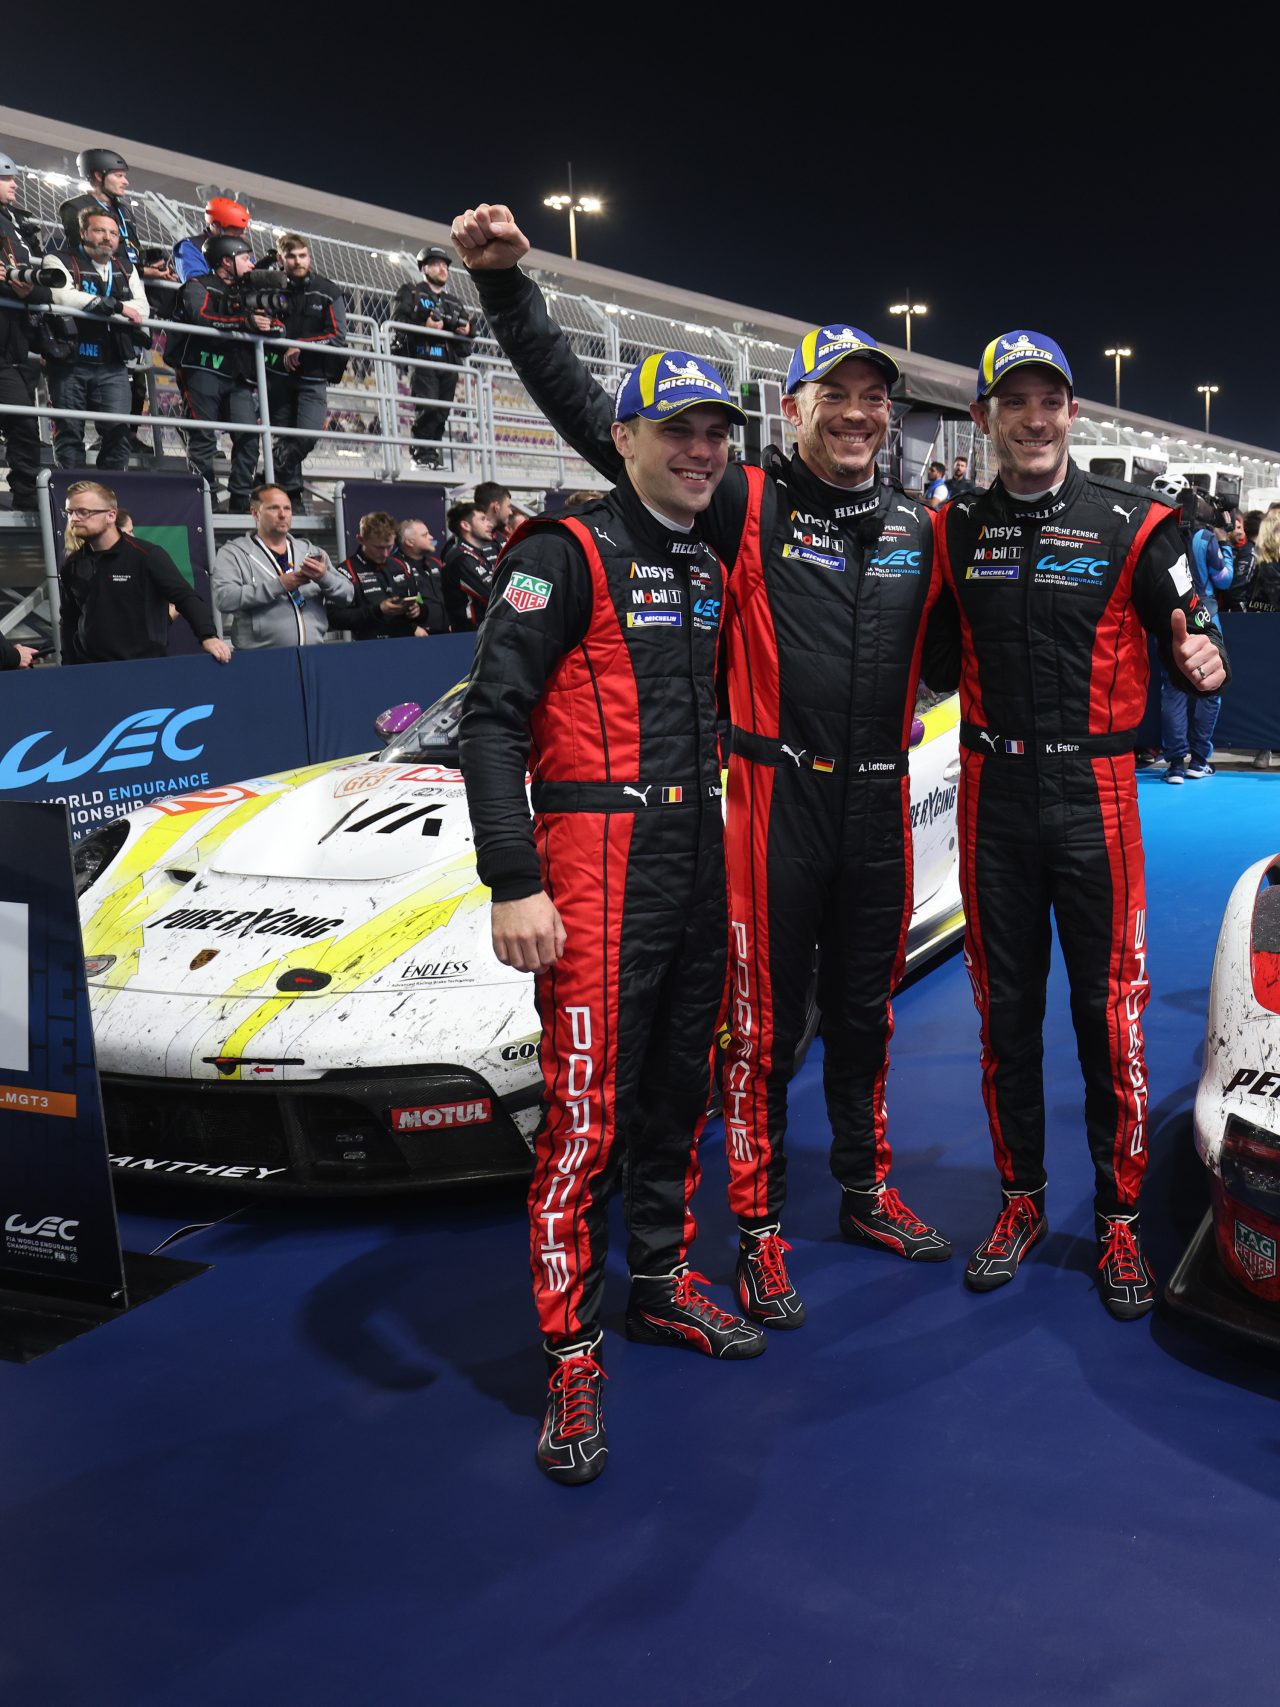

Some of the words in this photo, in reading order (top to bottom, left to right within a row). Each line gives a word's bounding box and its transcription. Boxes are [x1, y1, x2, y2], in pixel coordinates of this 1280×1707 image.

[200, 351, 224, 369] TV
[995, 349, 1053, 371] MICHELIN
[658, 381, 722, 395] MICHELIN
[834, 496, 880, 519] HELLER
[790, 510, 839, 532] Ansys
[793, 528, 830, 549] Mobil
[978, 525, 1022, 541] Ansys
[1041, 525, 1070, 536] PORSCHE
[1071, 530, 1099, 540] PENSKE
[1040, 538, 1084, 549] MOTORSPORT
[801, 552, 840, 567] MICHELIN
[974, 548, 1007, 560] Mobil
[630, 562, 675, 582] Ansys
[1036, 554, 1110, 577] WEC
[511, 574, 549, 595] TAG
[1034, 578, 1079, 587] CHAMPIONSHIP
[1067, 576, 1103, 586] ENDURANCE
[508, 588, 545, 610] HEUER
[632, 590, 667, 605] Mobil
[644, 614, 677, 622] MICHELIN
[0, 704, 215, 790] WEC
[1046, 743, 1056, 753] K.
[1057, 742, 1080, 753] Estre
[858, 764, 867, 773] A.
[868, 761, 896, 772] Lotterer
[108, 772, 210, 801] ENDURANCE
[343, 774, 388, 792] GT3
[401, 960, 471, 979] ENDLESS
[730, 920, 755, 1163] PORSCHE
[1124, 908, 1149, 1157] PORSCHE
[0, 1092, 49, 1108] MGT3
[398, 1102, 488, 1129] MOTUL
[540, 1005, 594, 1293] PORSCHE
[109, 1153, 287, 1180] ANTHEY
[5, 1214, 80, 1241] WEC
[7, 1242, 54, 1254] CHAMPIONSHIP
[17, 1237, 39, 1246] WORLD
[40, 1241, 78, 1253] ENDURANCE
[1236, 1223, 1273, 1255] TAG
[1236, 1244, 1274, 1277] HEUER
